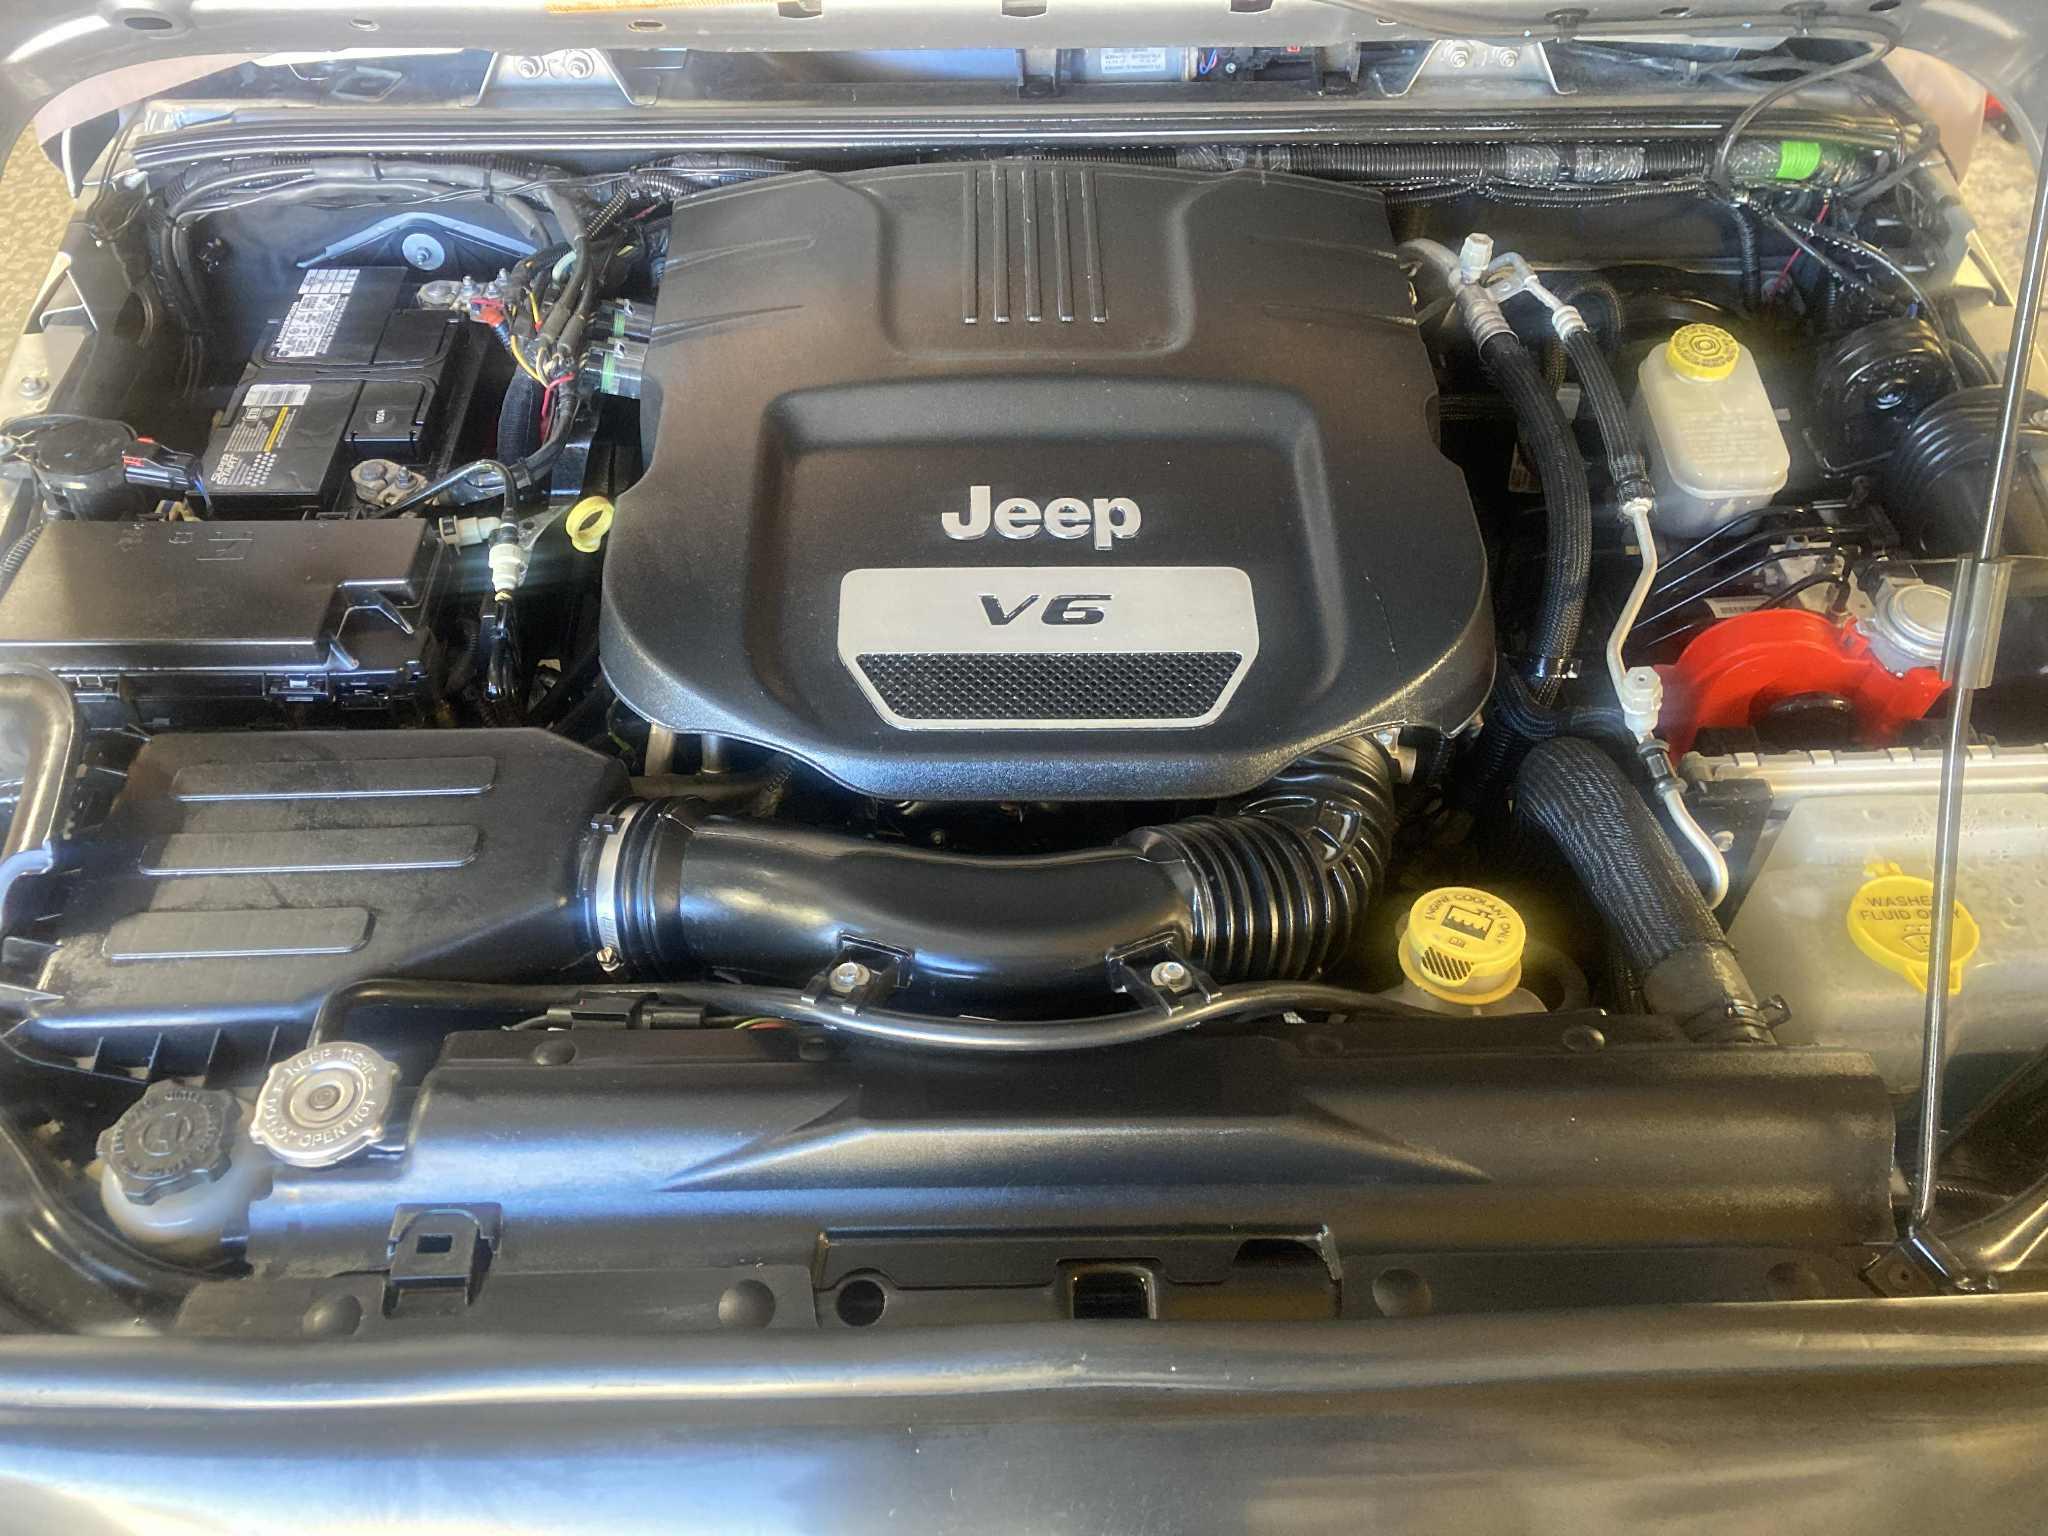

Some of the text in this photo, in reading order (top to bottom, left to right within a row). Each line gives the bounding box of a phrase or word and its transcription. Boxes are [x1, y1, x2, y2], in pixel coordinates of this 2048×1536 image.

[941, 485, 1142, 551] Jeep
[978, 594, 1113, 626] V6
[1454, 894, 1509, 920] COOLANT
[1866, 895, 1933, 907] WASHE
[1860, 909, 1911, 921] FLUID
[298, 1127, 348, 1148] OPEN
